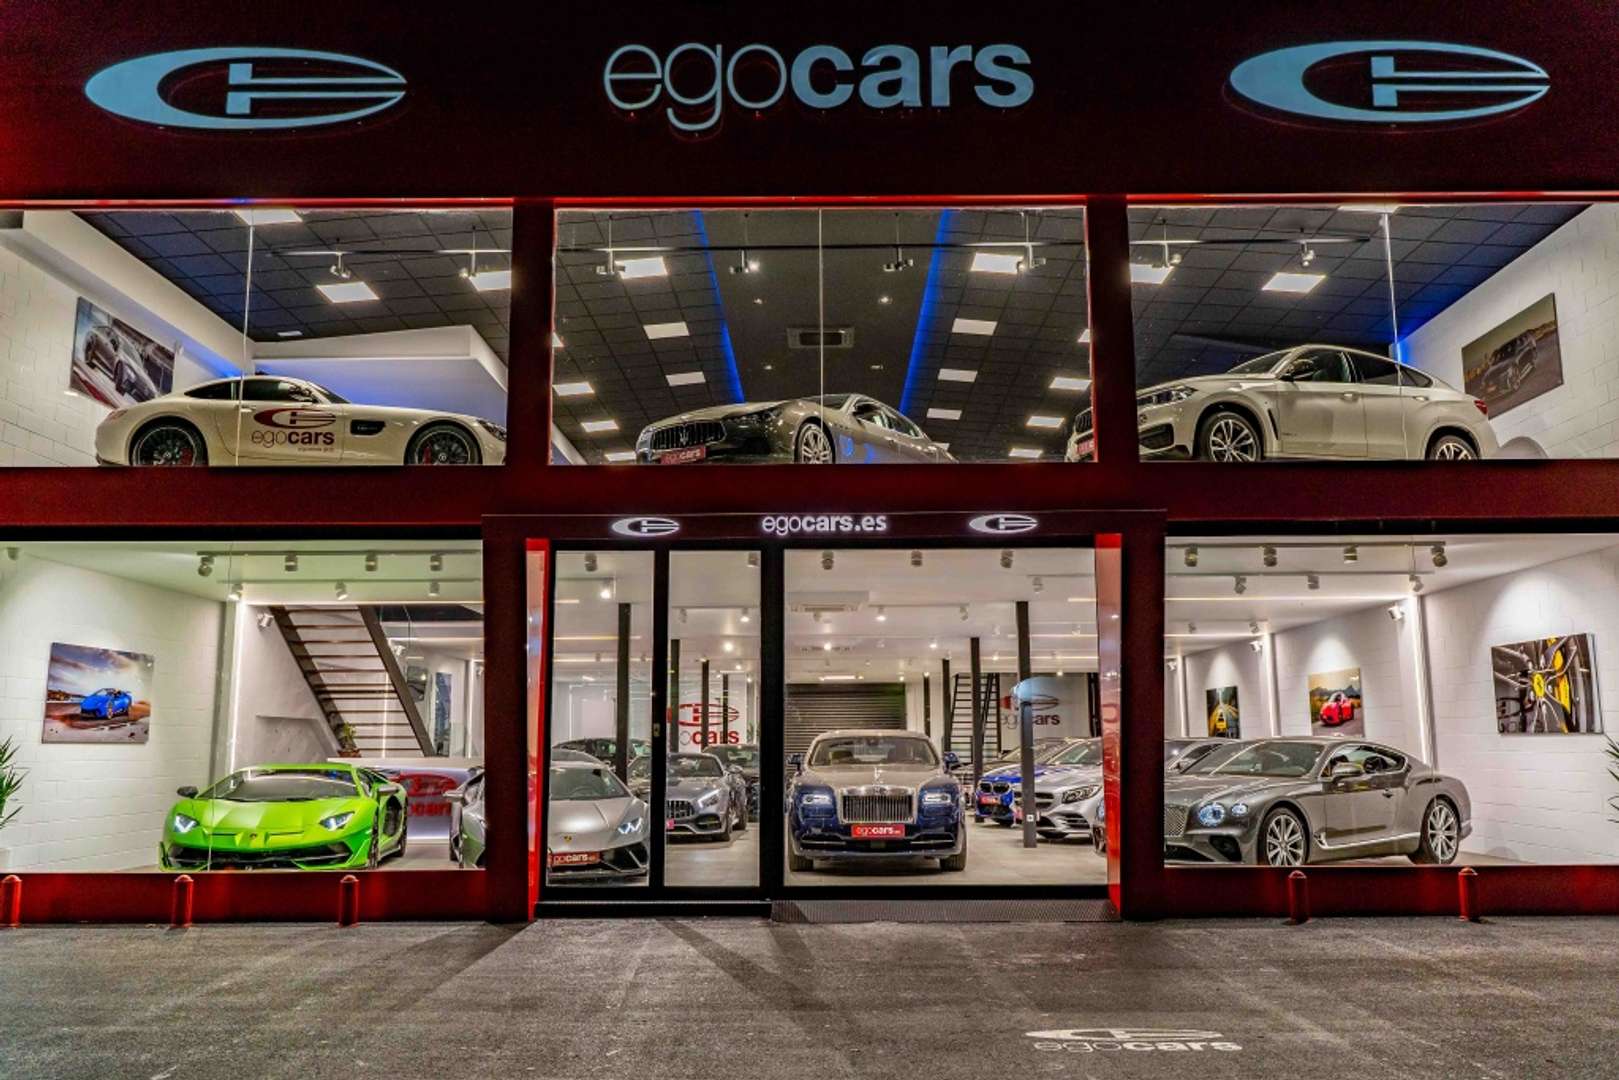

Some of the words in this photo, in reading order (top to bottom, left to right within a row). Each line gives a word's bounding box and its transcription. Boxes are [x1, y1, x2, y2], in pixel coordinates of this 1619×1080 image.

[604, 42, 1035, 131] egocars
[251, 430, 335, 448] egocars
[762, 515, 887, 535] egocars.es
[1033, 1041, 1243, 1052] egocars
